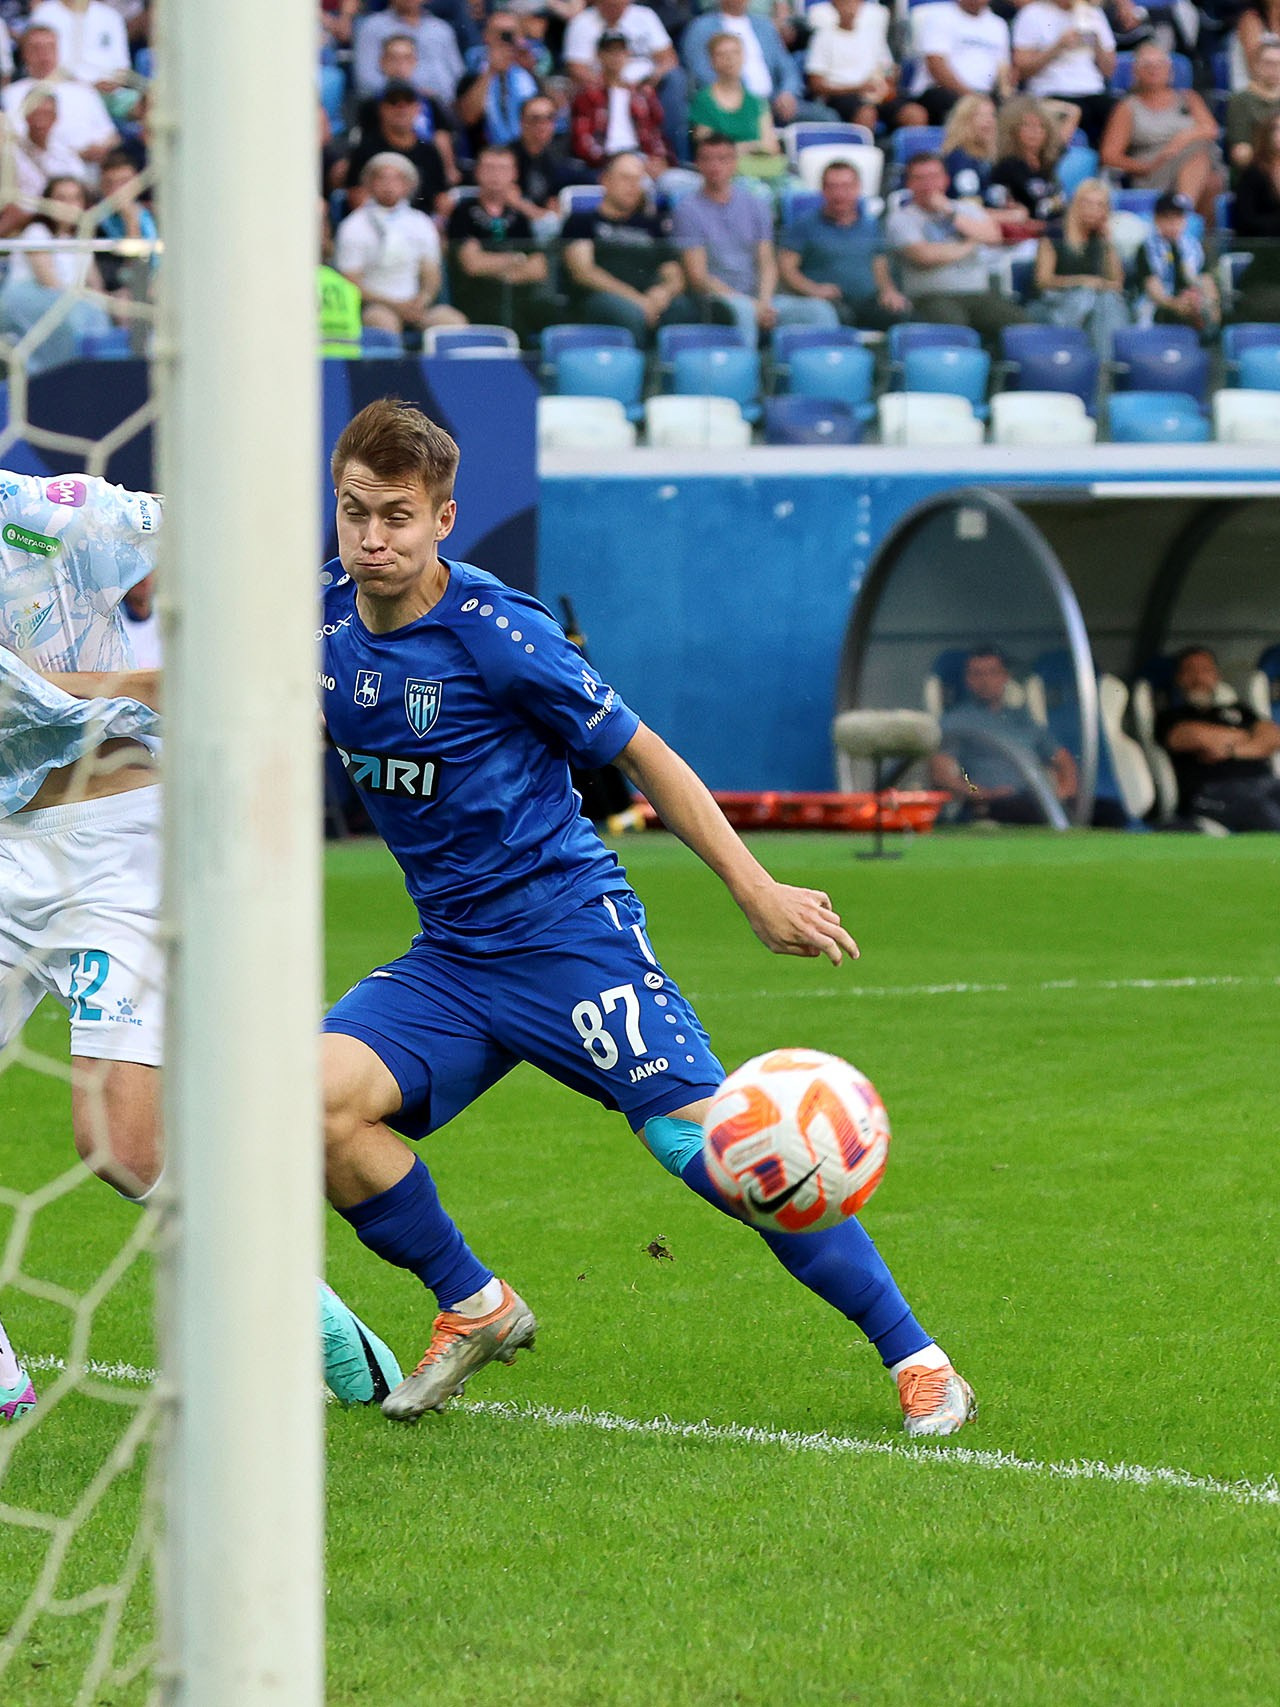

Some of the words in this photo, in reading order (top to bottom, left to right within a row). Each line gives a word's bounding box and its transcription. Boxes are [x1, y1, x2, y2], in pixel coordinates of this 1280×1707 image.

[16, 533, 58, 552] МЕГАФОН
[409, 683, 437, 695] PARI
[108, 1015, 143, 1026] KELME
[571, 983, 648, 1070] 87
[628, 1057, 669, 1083] JAKO
